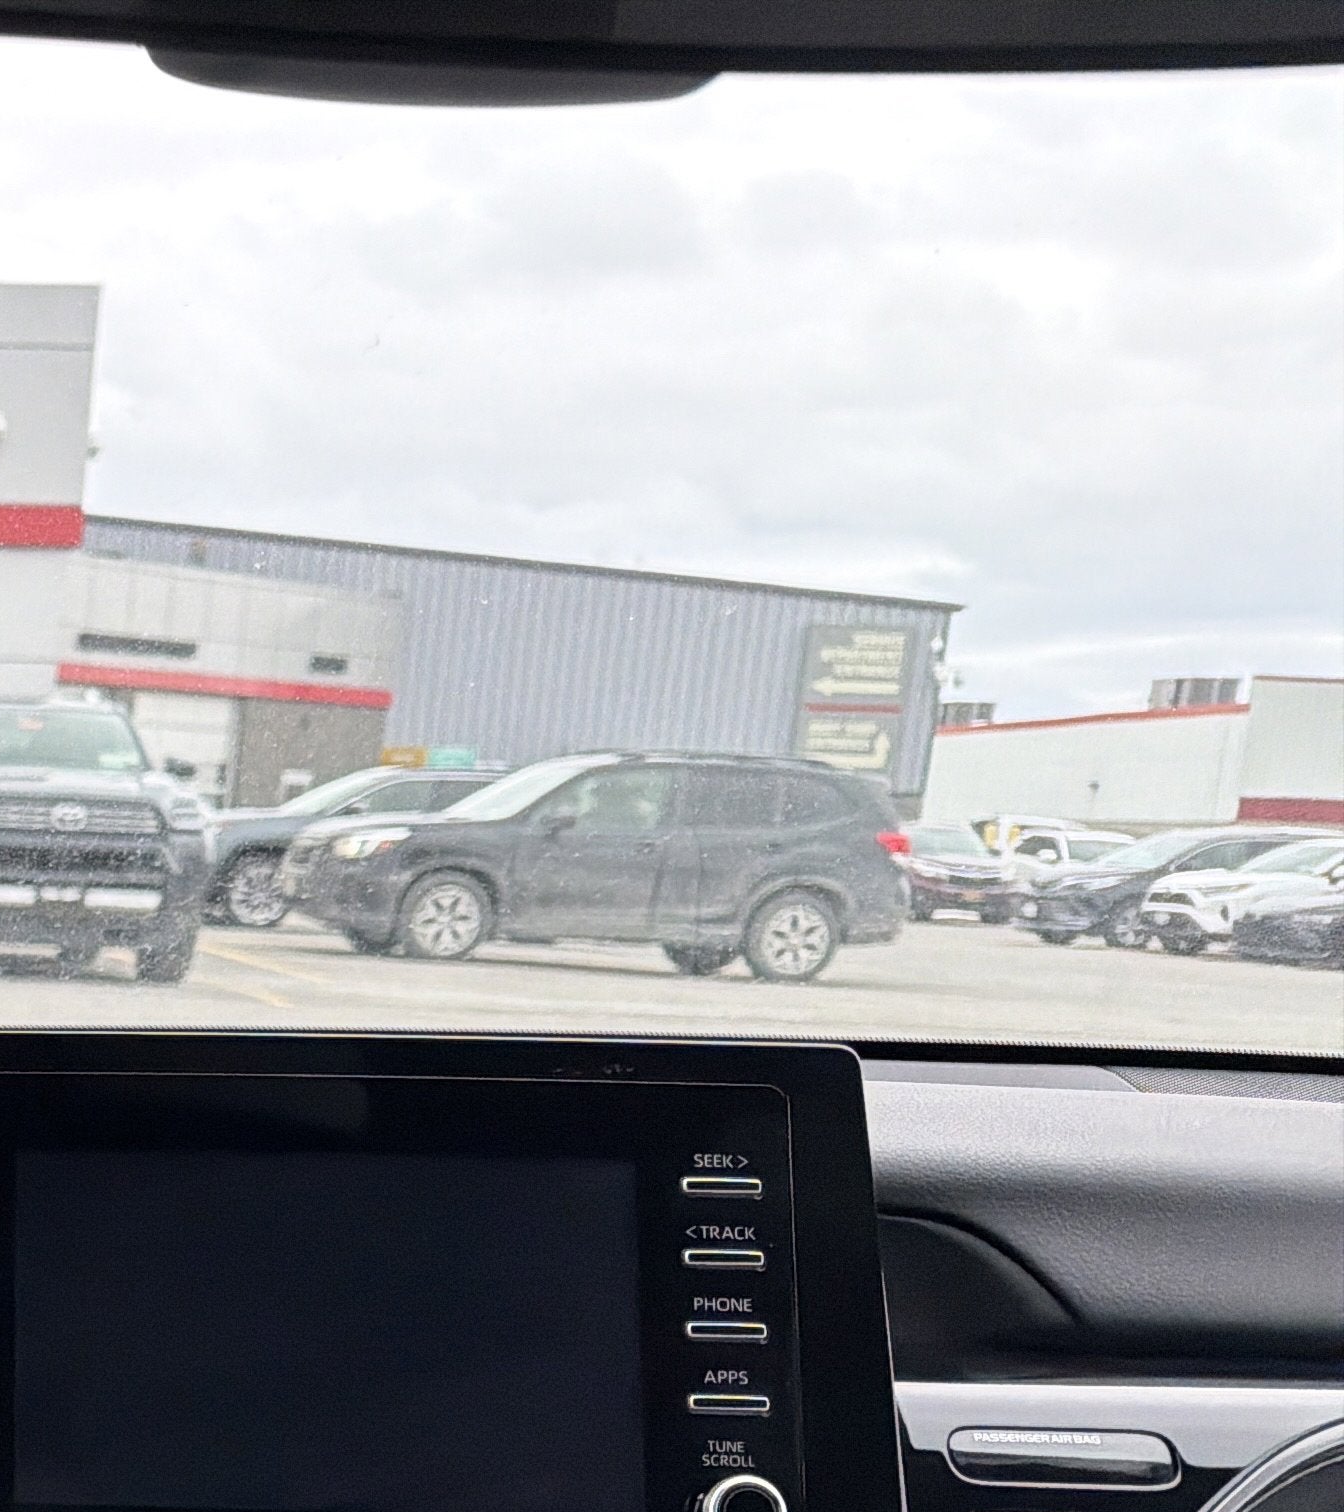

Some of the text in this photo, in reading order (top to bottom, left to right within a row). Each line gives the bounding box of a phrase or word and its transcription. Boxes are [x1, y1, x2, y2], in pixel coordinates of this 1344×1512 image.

[693, 1153, 734, 1168] SEEK
[700, 1225, 756, 1240] TRACK
[693, 1297, 753, 1312] PHONE
[703, 1370, 749, 1385] APPS
[973, 1432, 1050, 1444] PASSENGER
[707, 1439, 746, 1453] TUNE
[701, 1453, 755, 1468] SCROLL
